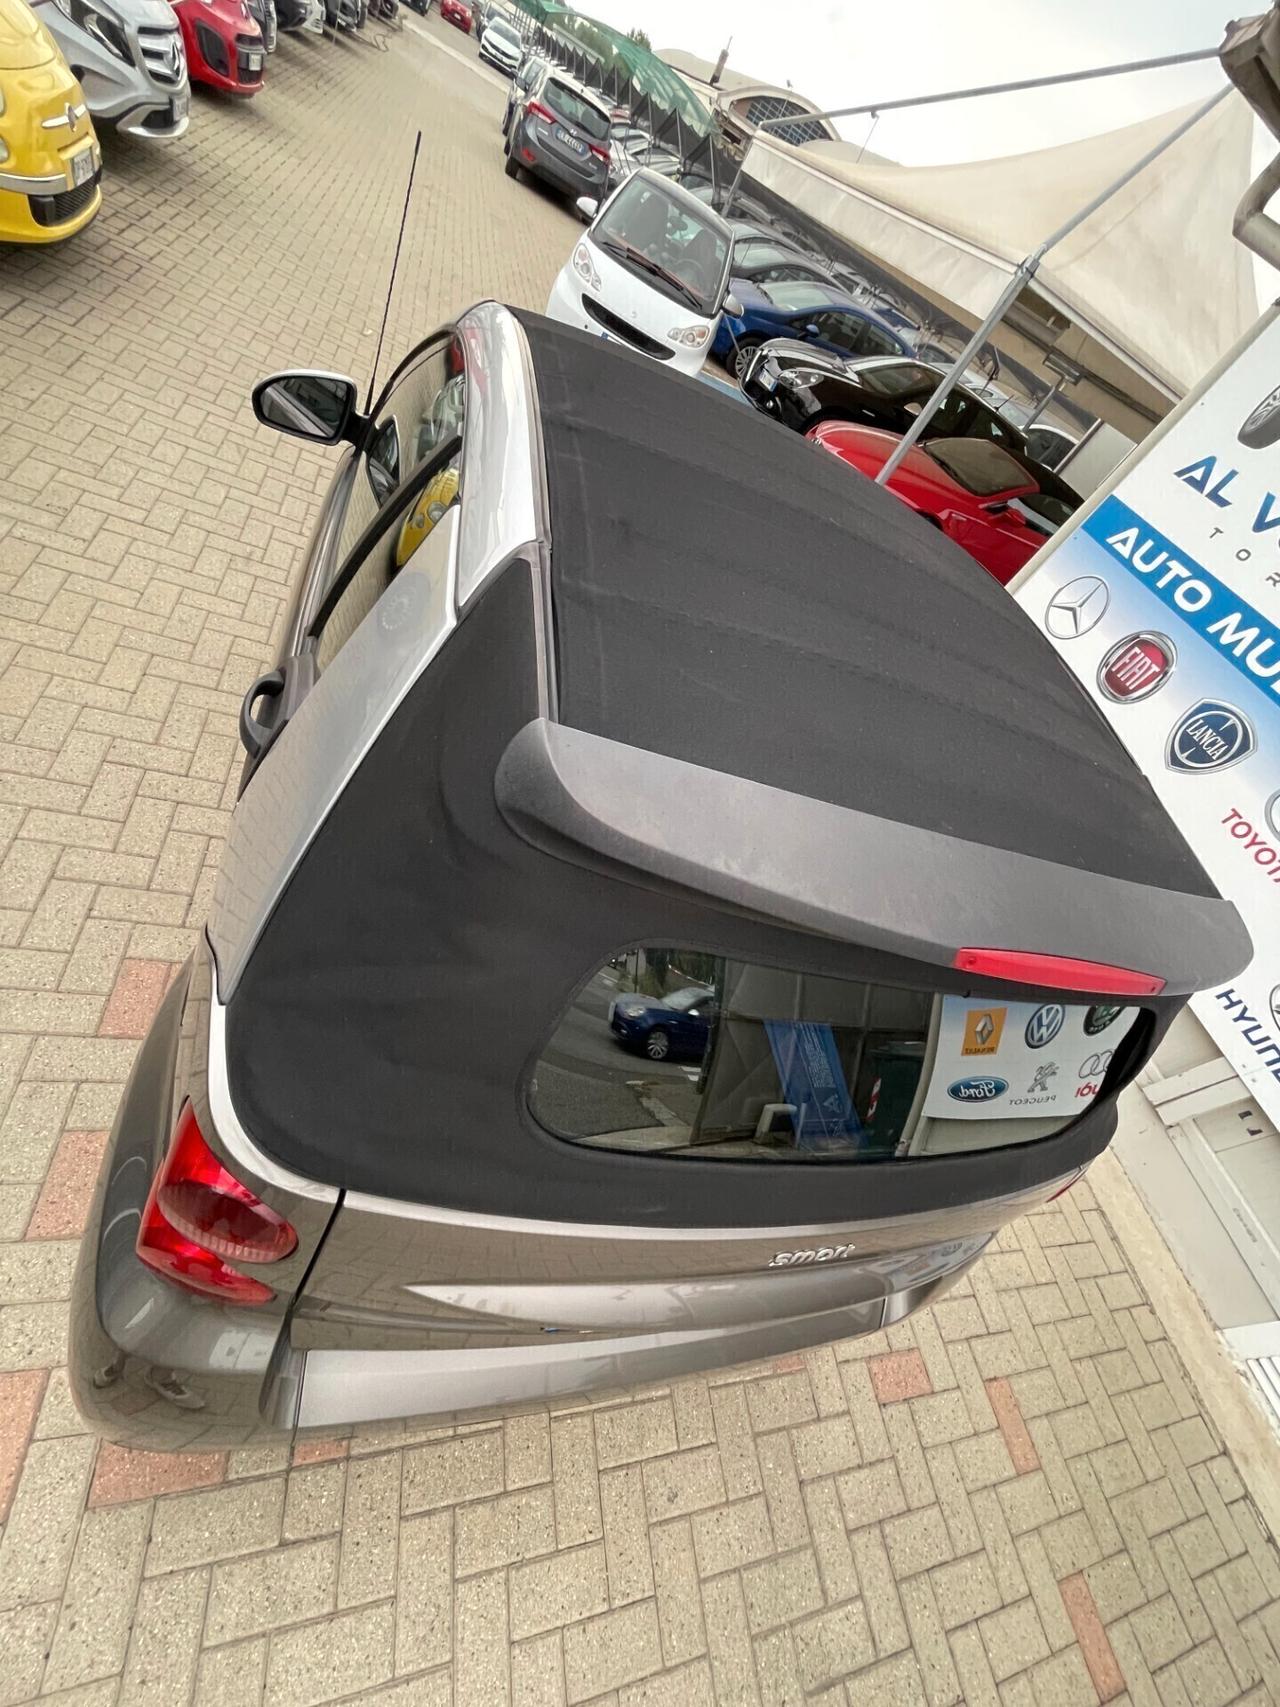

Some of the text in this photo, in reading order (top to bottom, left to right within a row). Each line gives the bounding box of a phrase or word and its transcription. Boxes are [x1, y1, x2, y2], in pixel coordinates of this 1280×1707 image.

[1173, 455, 1280, 548] AL V
[1105, 526, 1280, 695] AUTO MU
[1111, 646, 1161, 690] FIAT
[1185, 719, 1229, 760] LANCIA
[1221, 807, 1280, 883] TOYOT
[768, 1243, 856, 1267] smart
